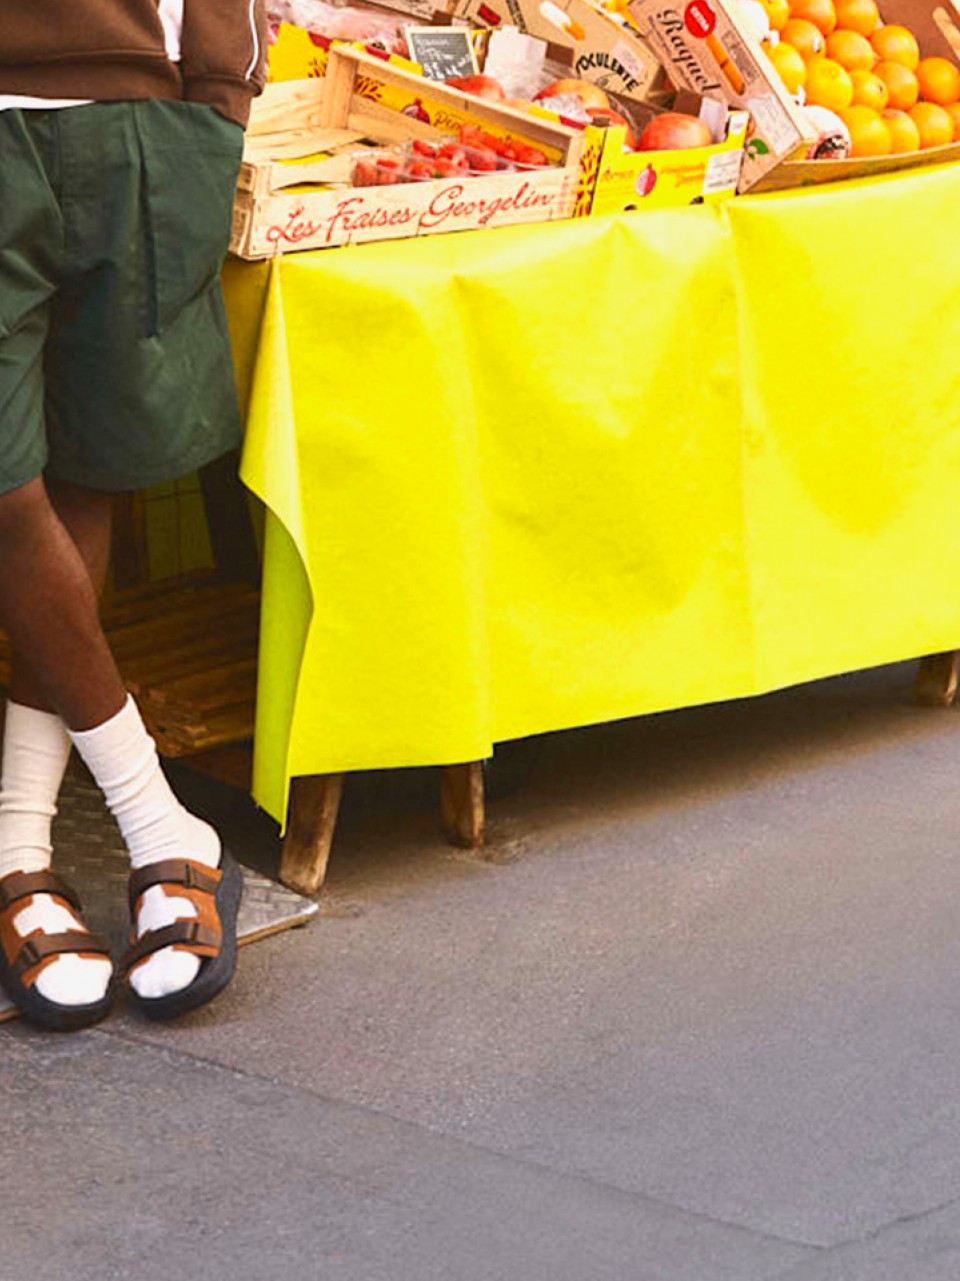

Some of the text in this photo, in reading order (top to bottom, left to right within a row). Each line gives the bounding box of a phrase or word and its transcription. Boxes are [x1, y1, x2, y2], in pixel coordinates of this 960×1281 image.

[656, 8, 722, 93] Raquel
[266, 184, 556, 243] Les Fraises Georgelin
